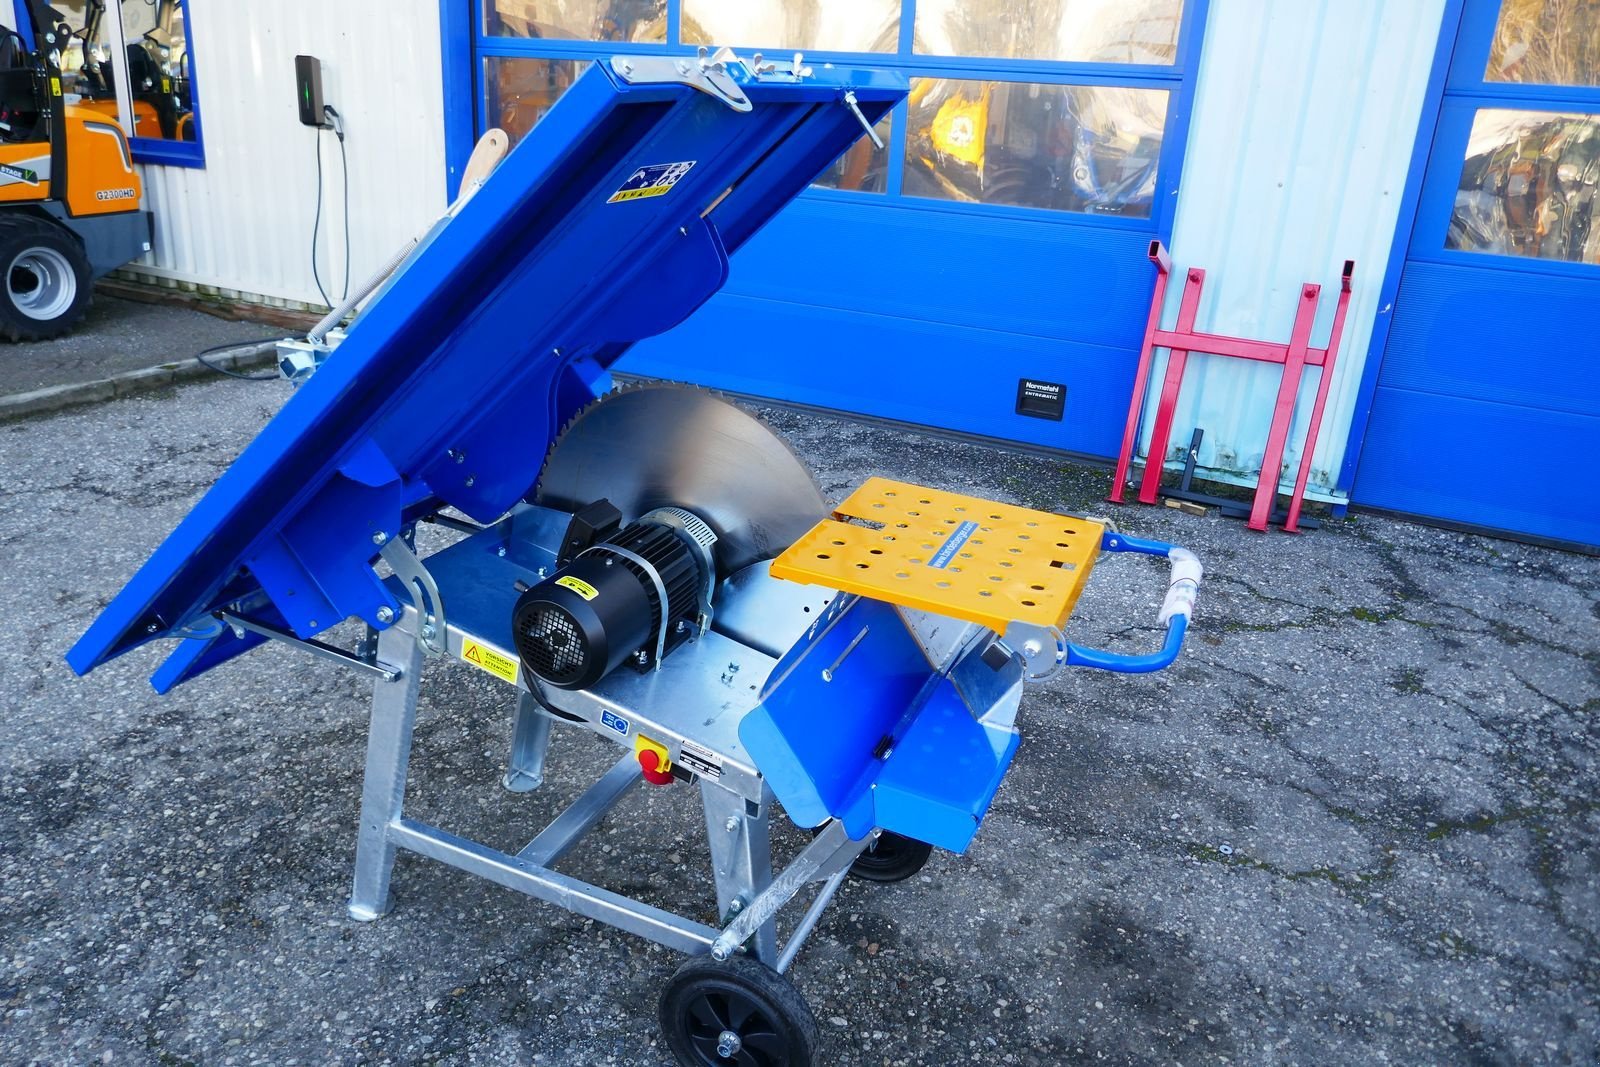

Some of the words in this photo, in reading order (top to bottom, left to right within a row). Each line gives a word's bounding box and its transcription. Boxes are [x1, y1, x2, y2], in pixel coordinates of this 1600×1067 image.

[1, 166, 23, 178] STAGE
[96, 189, 135, 200] G2300HD
[1025, 381, 1060, 393] Normstahl
[485, 651, 514, 668] VORSICHT!
